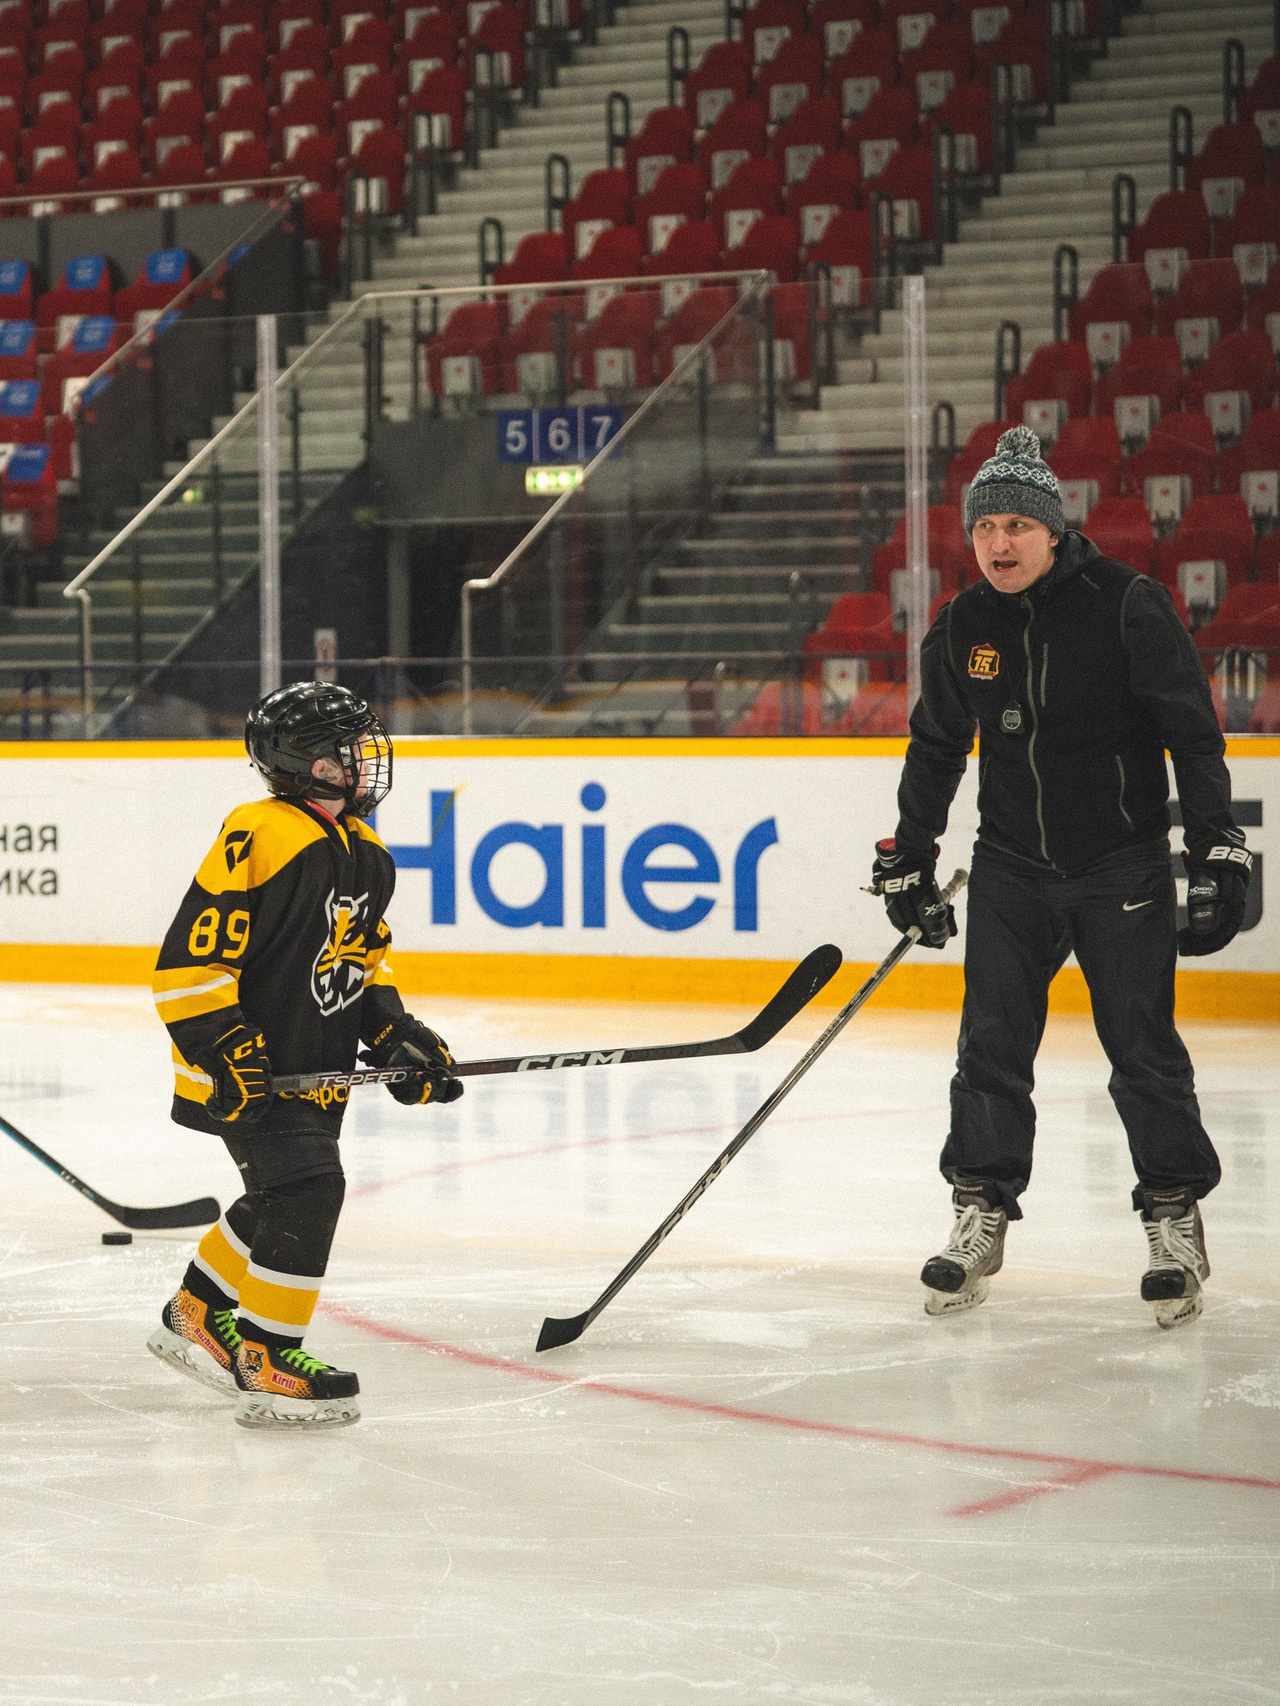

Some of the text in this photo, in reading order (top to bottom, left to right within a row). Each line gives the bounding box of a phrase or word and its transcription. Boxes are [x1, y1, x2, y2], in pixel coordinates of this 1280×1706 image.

[505, 415, 613, 454] 5 6 7
[369, 781, 780, 933] Haier
[187, 906, 250, 960] 89
[373, 1023, 394, 1047] CCM
[517, 1049, 626, 1072] CCM
[178, 1296, 200, 1322] 89
[193, 1327, 228, 1363] Ruzhanov
[271, 1371, 297, 1392] Kirill
